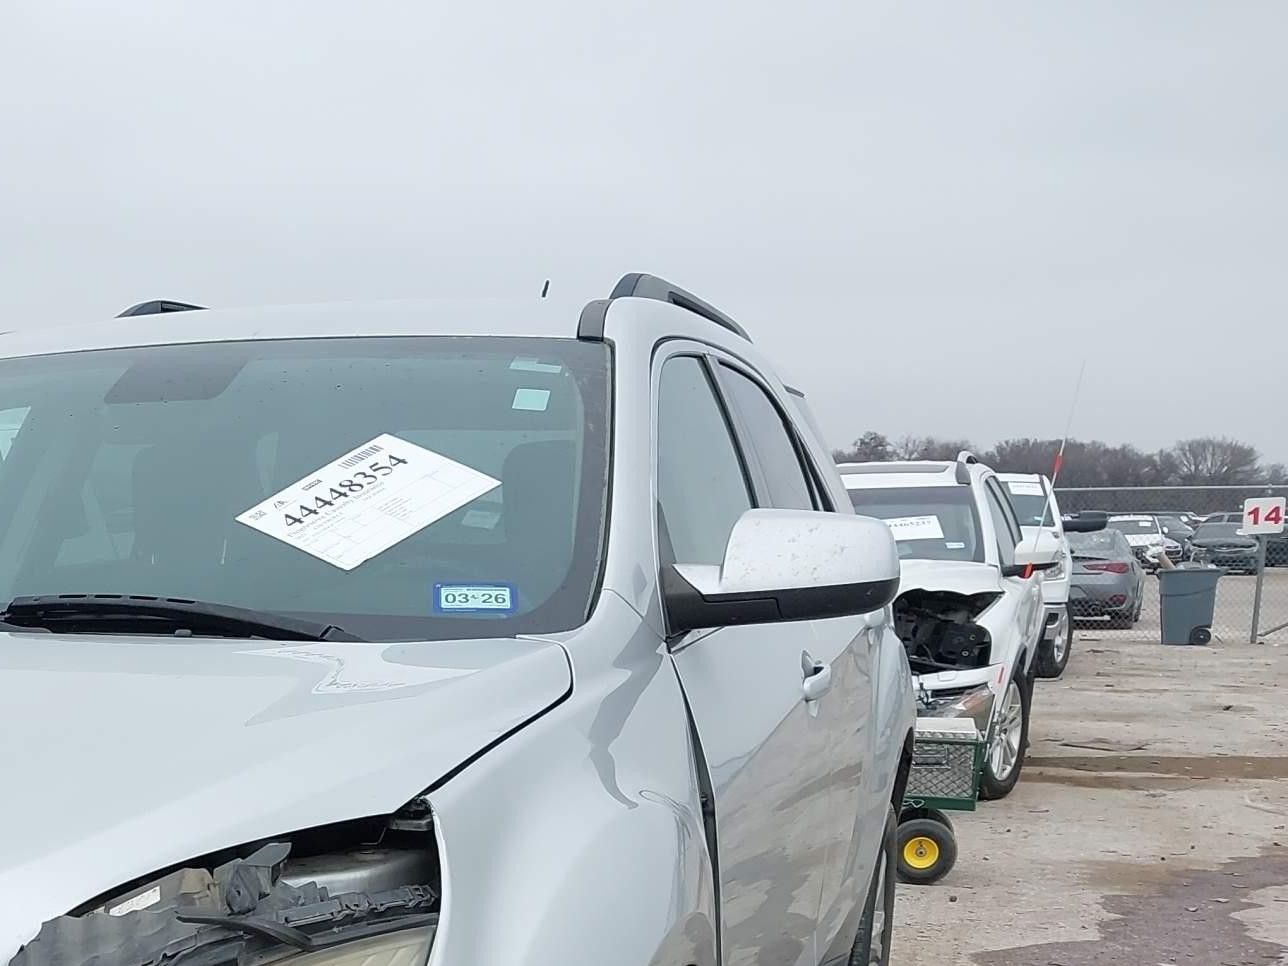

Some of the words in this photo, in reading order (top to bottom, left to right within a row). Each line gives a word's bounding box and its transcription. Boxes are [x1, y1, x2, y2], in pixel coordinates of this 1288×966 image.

[284, 454, 409, 527] 44448354
[1247, 506, 1282, 525] 14
[444, 592, 470, 604] 03
[481, 592, 507, 604] 26
